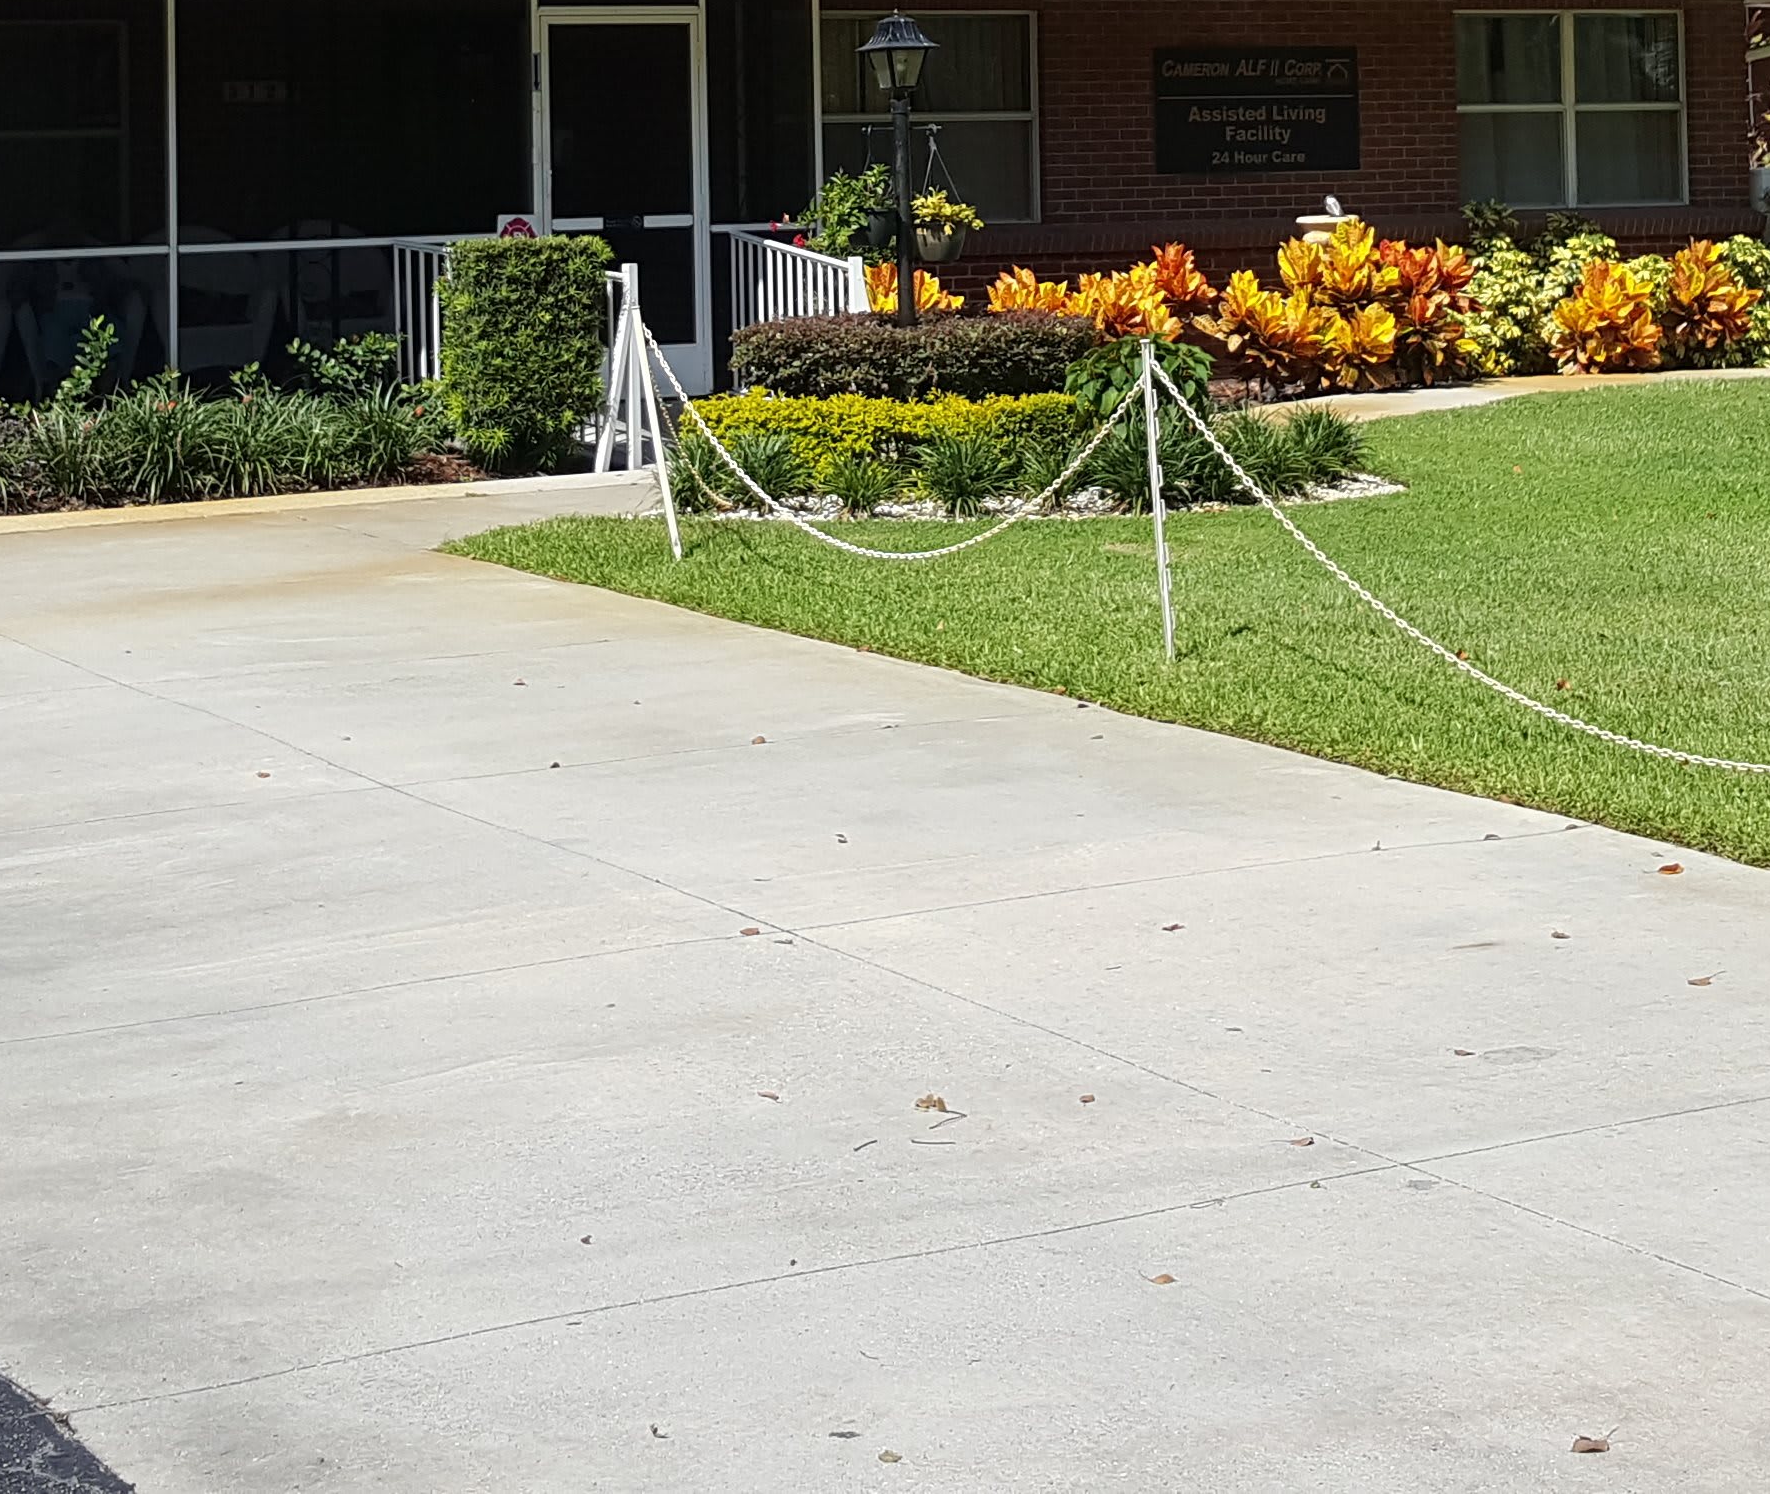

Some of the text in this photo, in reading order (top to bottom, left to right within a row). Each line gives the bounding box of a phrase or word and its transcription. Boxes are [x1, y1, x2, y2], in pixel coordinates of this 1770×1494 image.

[1235, 59, 1266, 77] ALF
[1188, 106, 1326, 124] Assisted Living
[1225, 125, 1292, 144] Facility
[1212, 151, 1306, 165] 24 Hour Care
